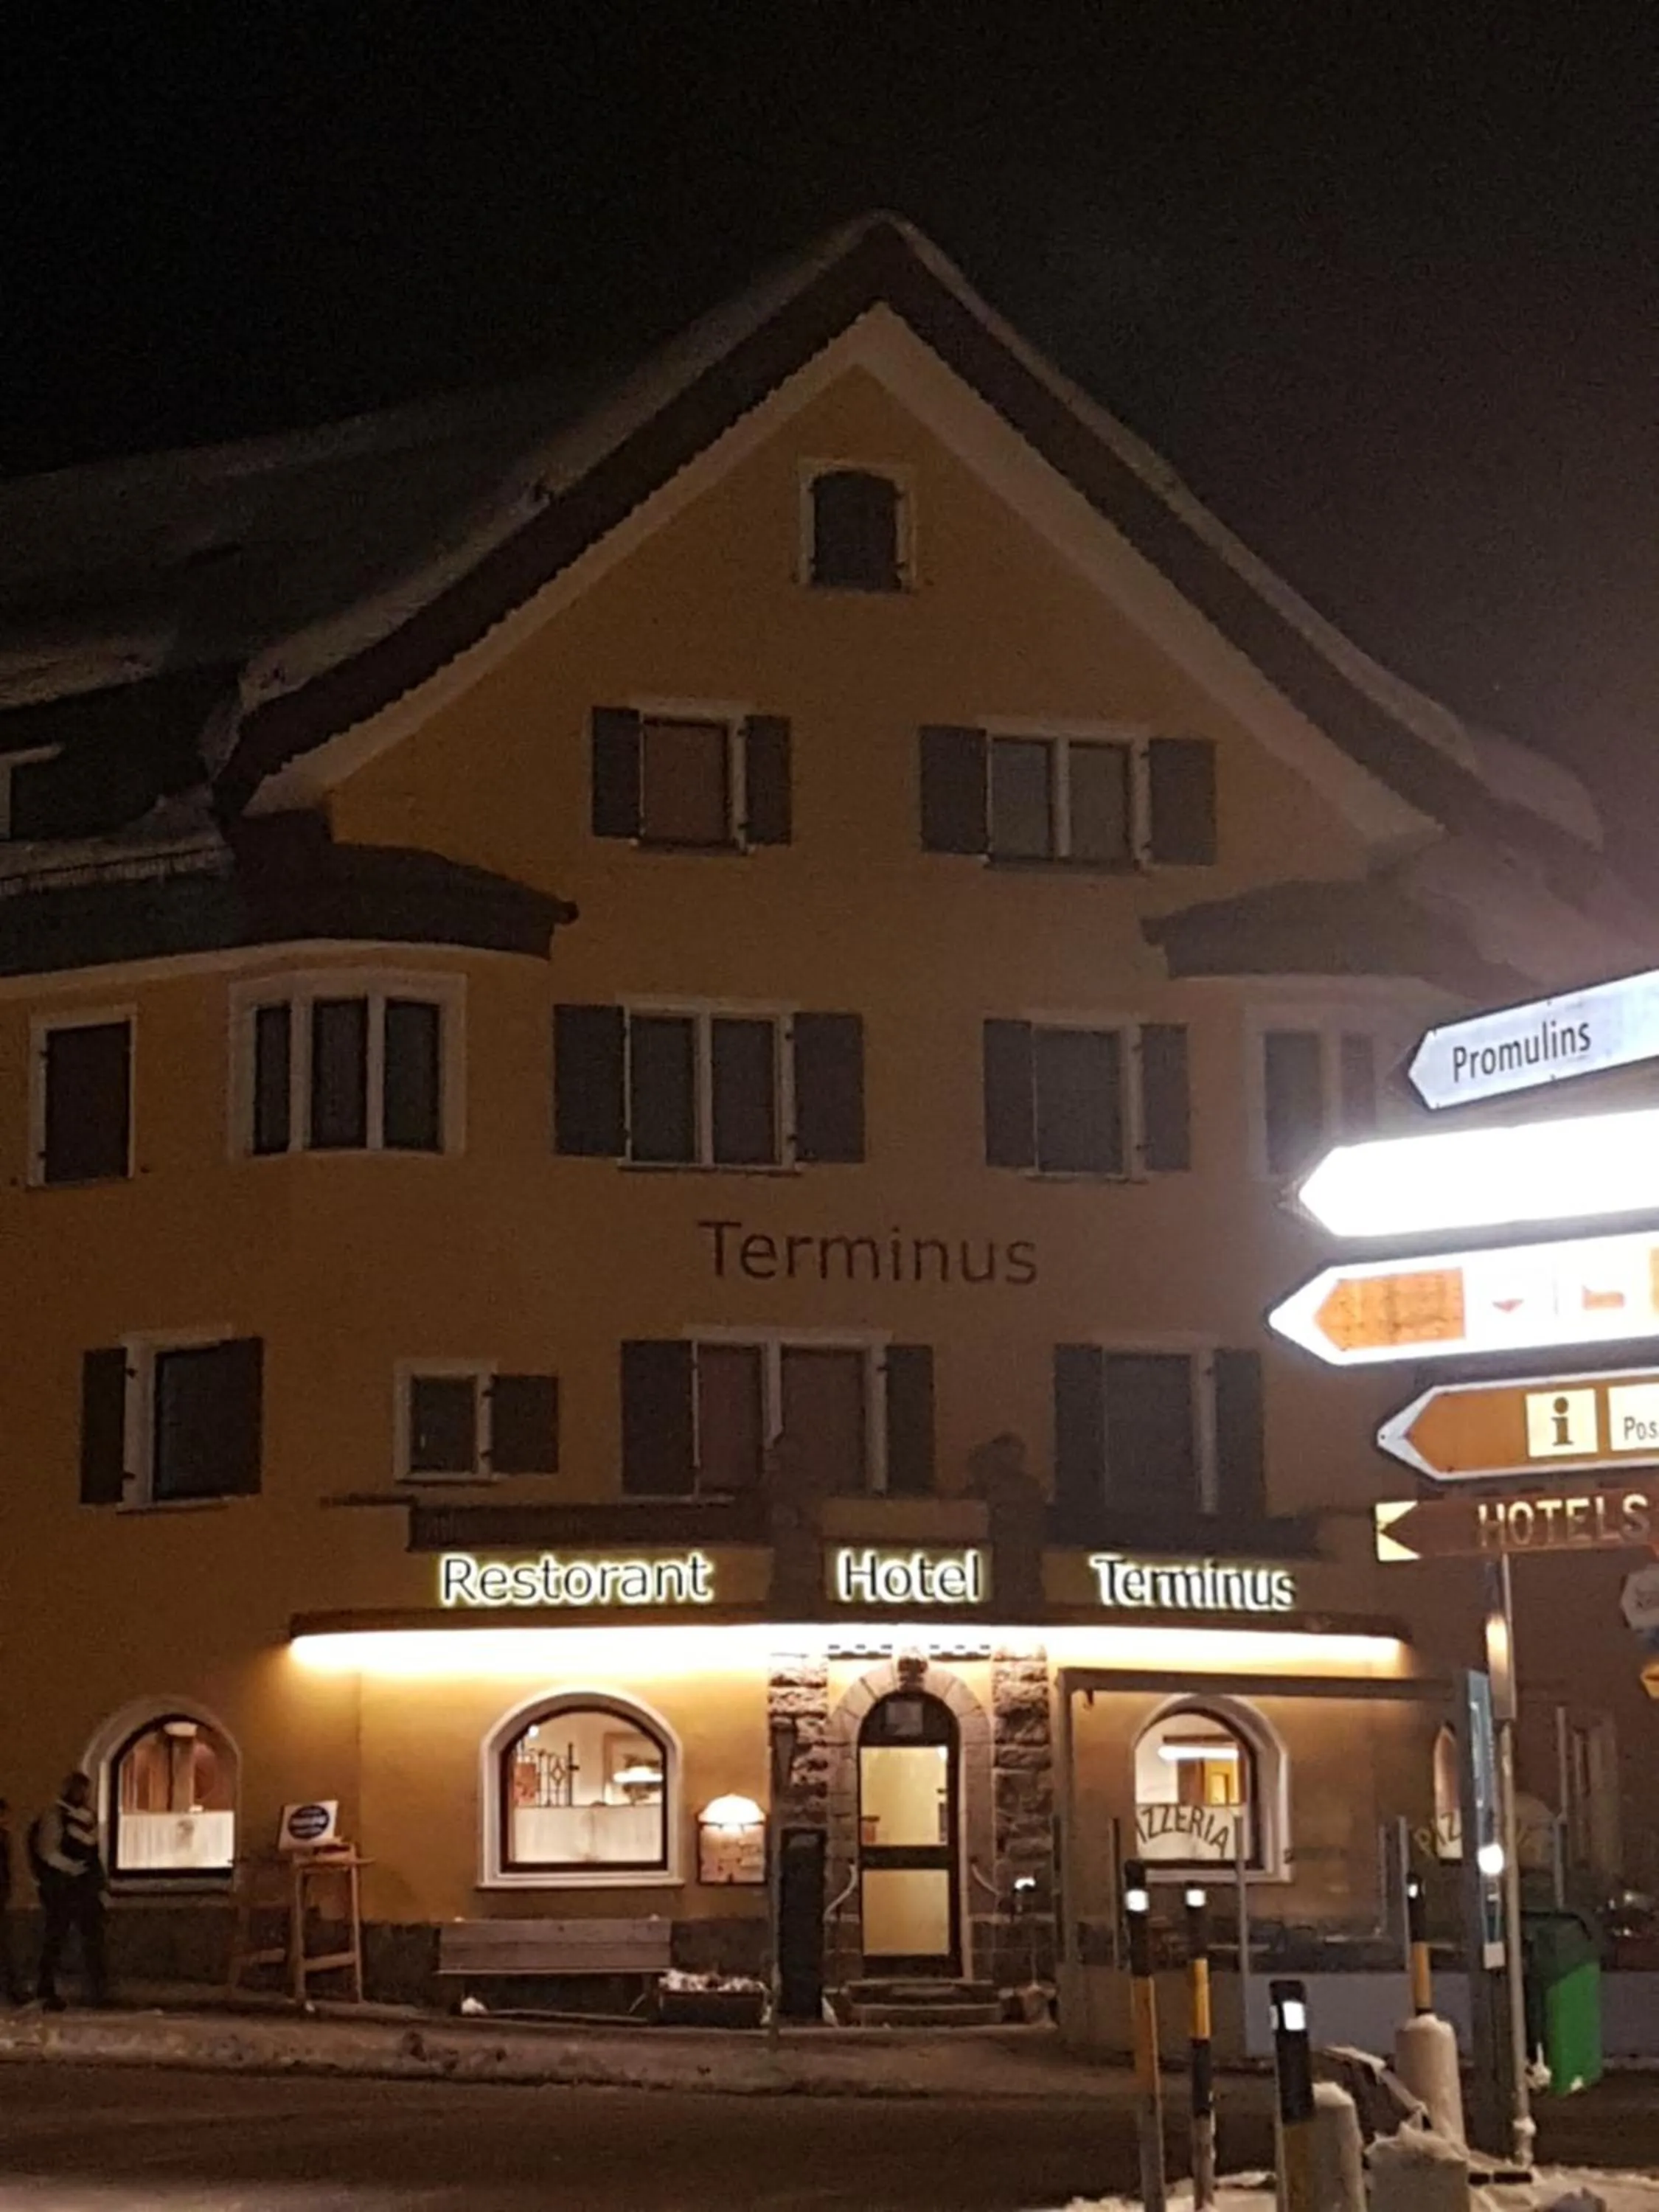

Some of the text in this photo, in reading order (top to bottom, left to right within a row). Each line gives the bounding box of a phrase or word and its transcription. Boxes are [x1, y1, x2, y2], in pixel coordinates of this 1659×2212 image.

[1452, 1020, 1592, 1083] Promulins
[697, 1219, 1038, 1285] Terminus
[1478, 1493, 1650, 1548] HOTELS
[442, 1548, 1296, 1610] Restorant Hotel Terminus
